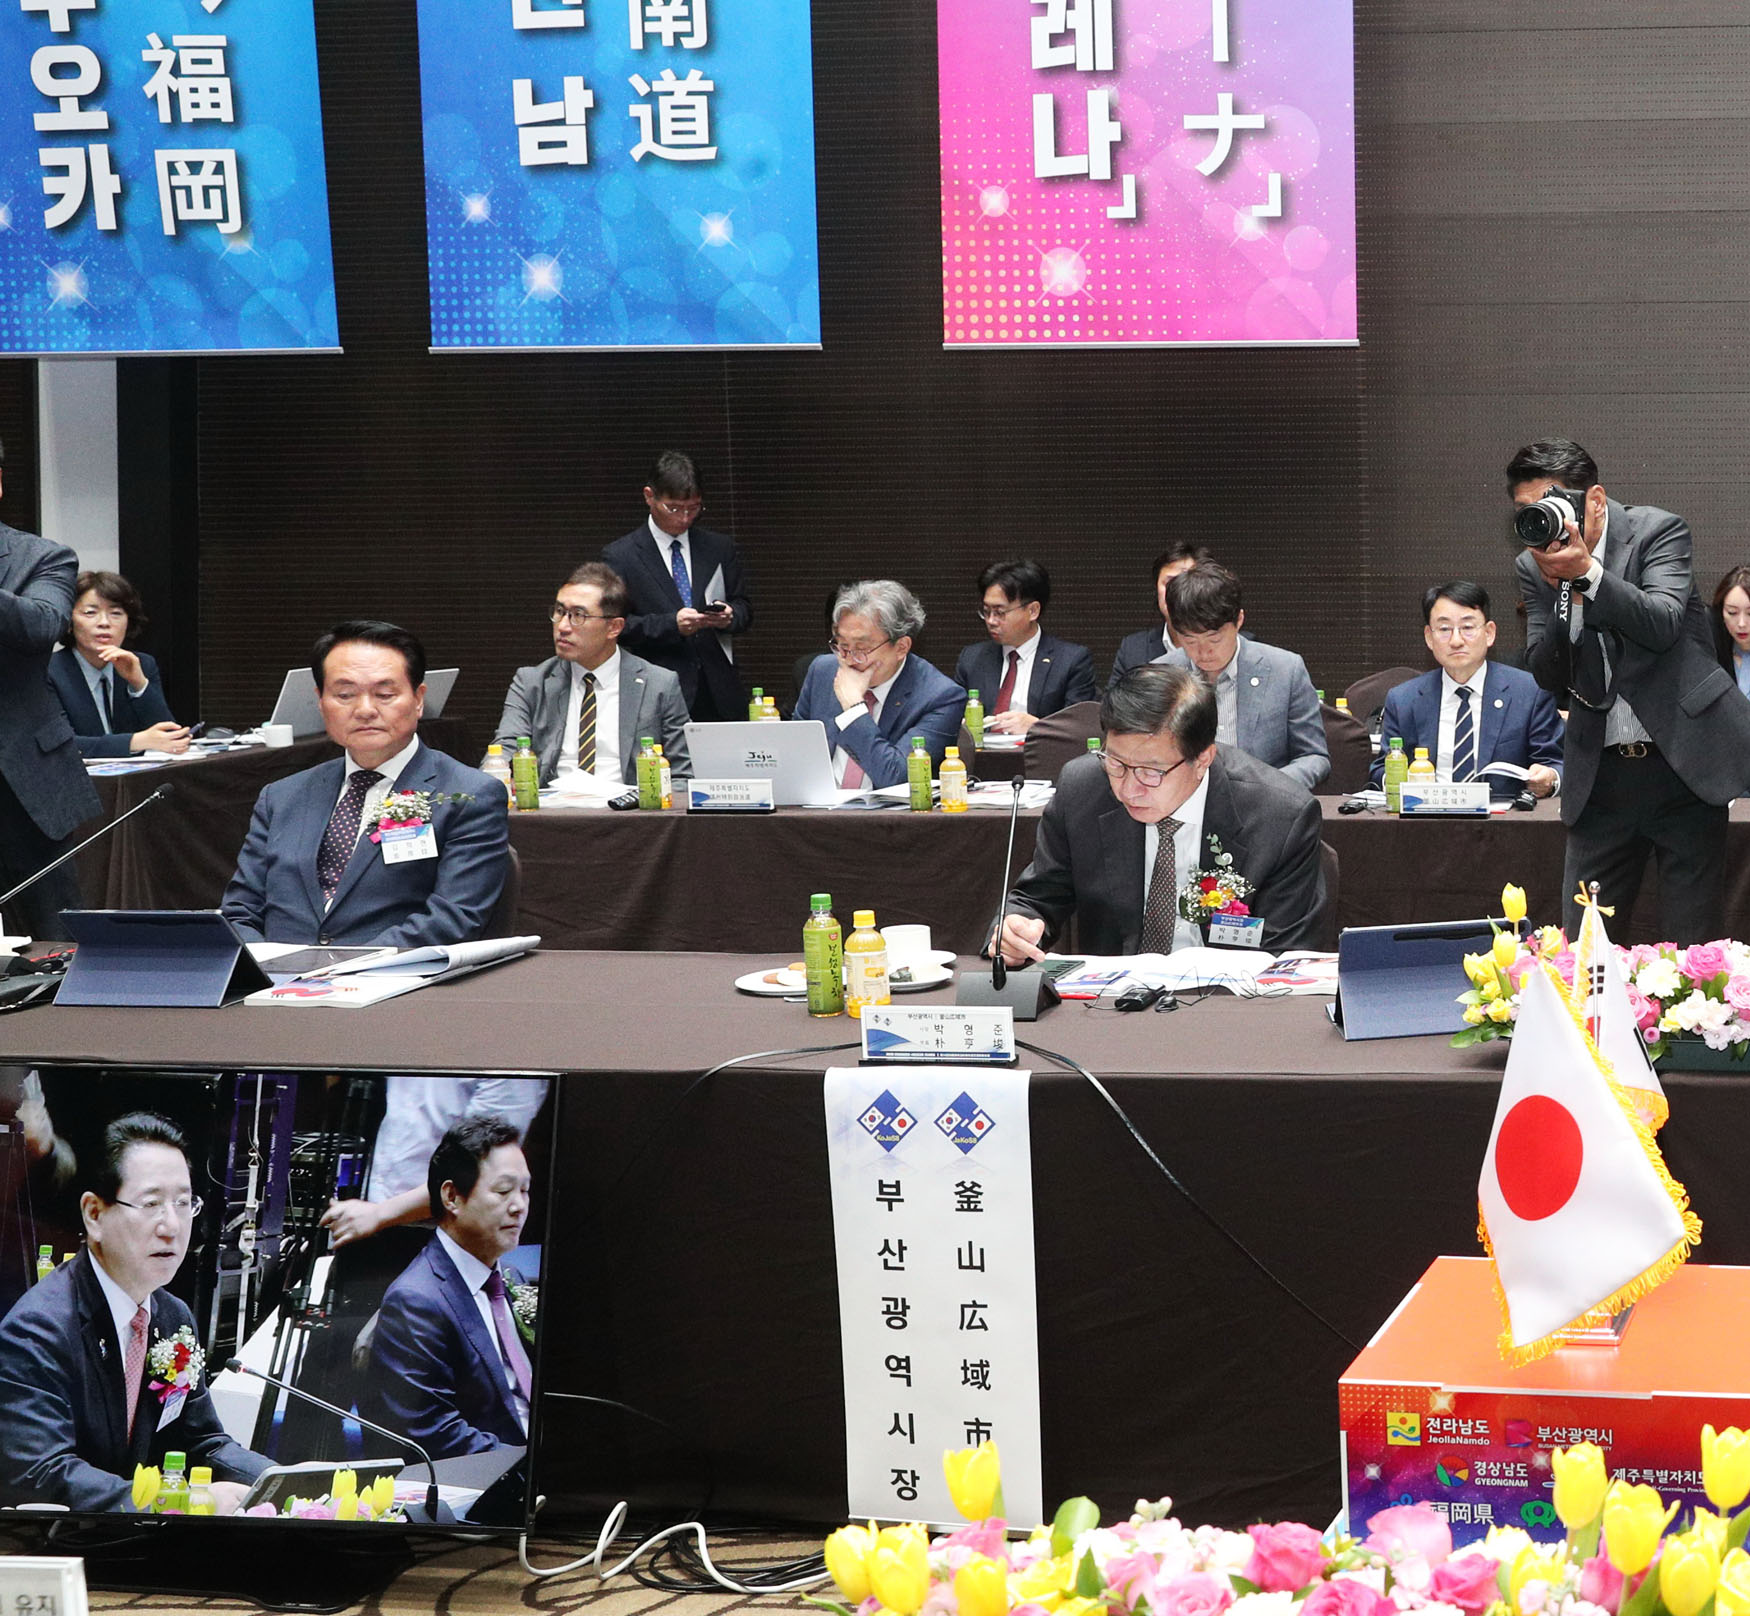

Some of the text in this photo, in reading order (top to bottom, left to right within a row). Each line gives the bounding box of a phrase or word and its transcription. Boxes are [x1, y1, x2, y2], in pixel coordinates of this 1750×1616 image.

[141, 32, 242, 235] 福岡
[1559, 581, 1570, 622] SONY
[875, 1179, 920, 1501] 부산광역시장
[1426, 1417, 1490, 1435] 전라남도
[1536, 1425, 1614, 1445] 부산광역시
[1427, 1435, 1490, 1446] JeollaNamdo
[1474, 1461, 1529, 1477] 경상남도
[1474, 1478, 1529, 1488] GYEONGNAM
